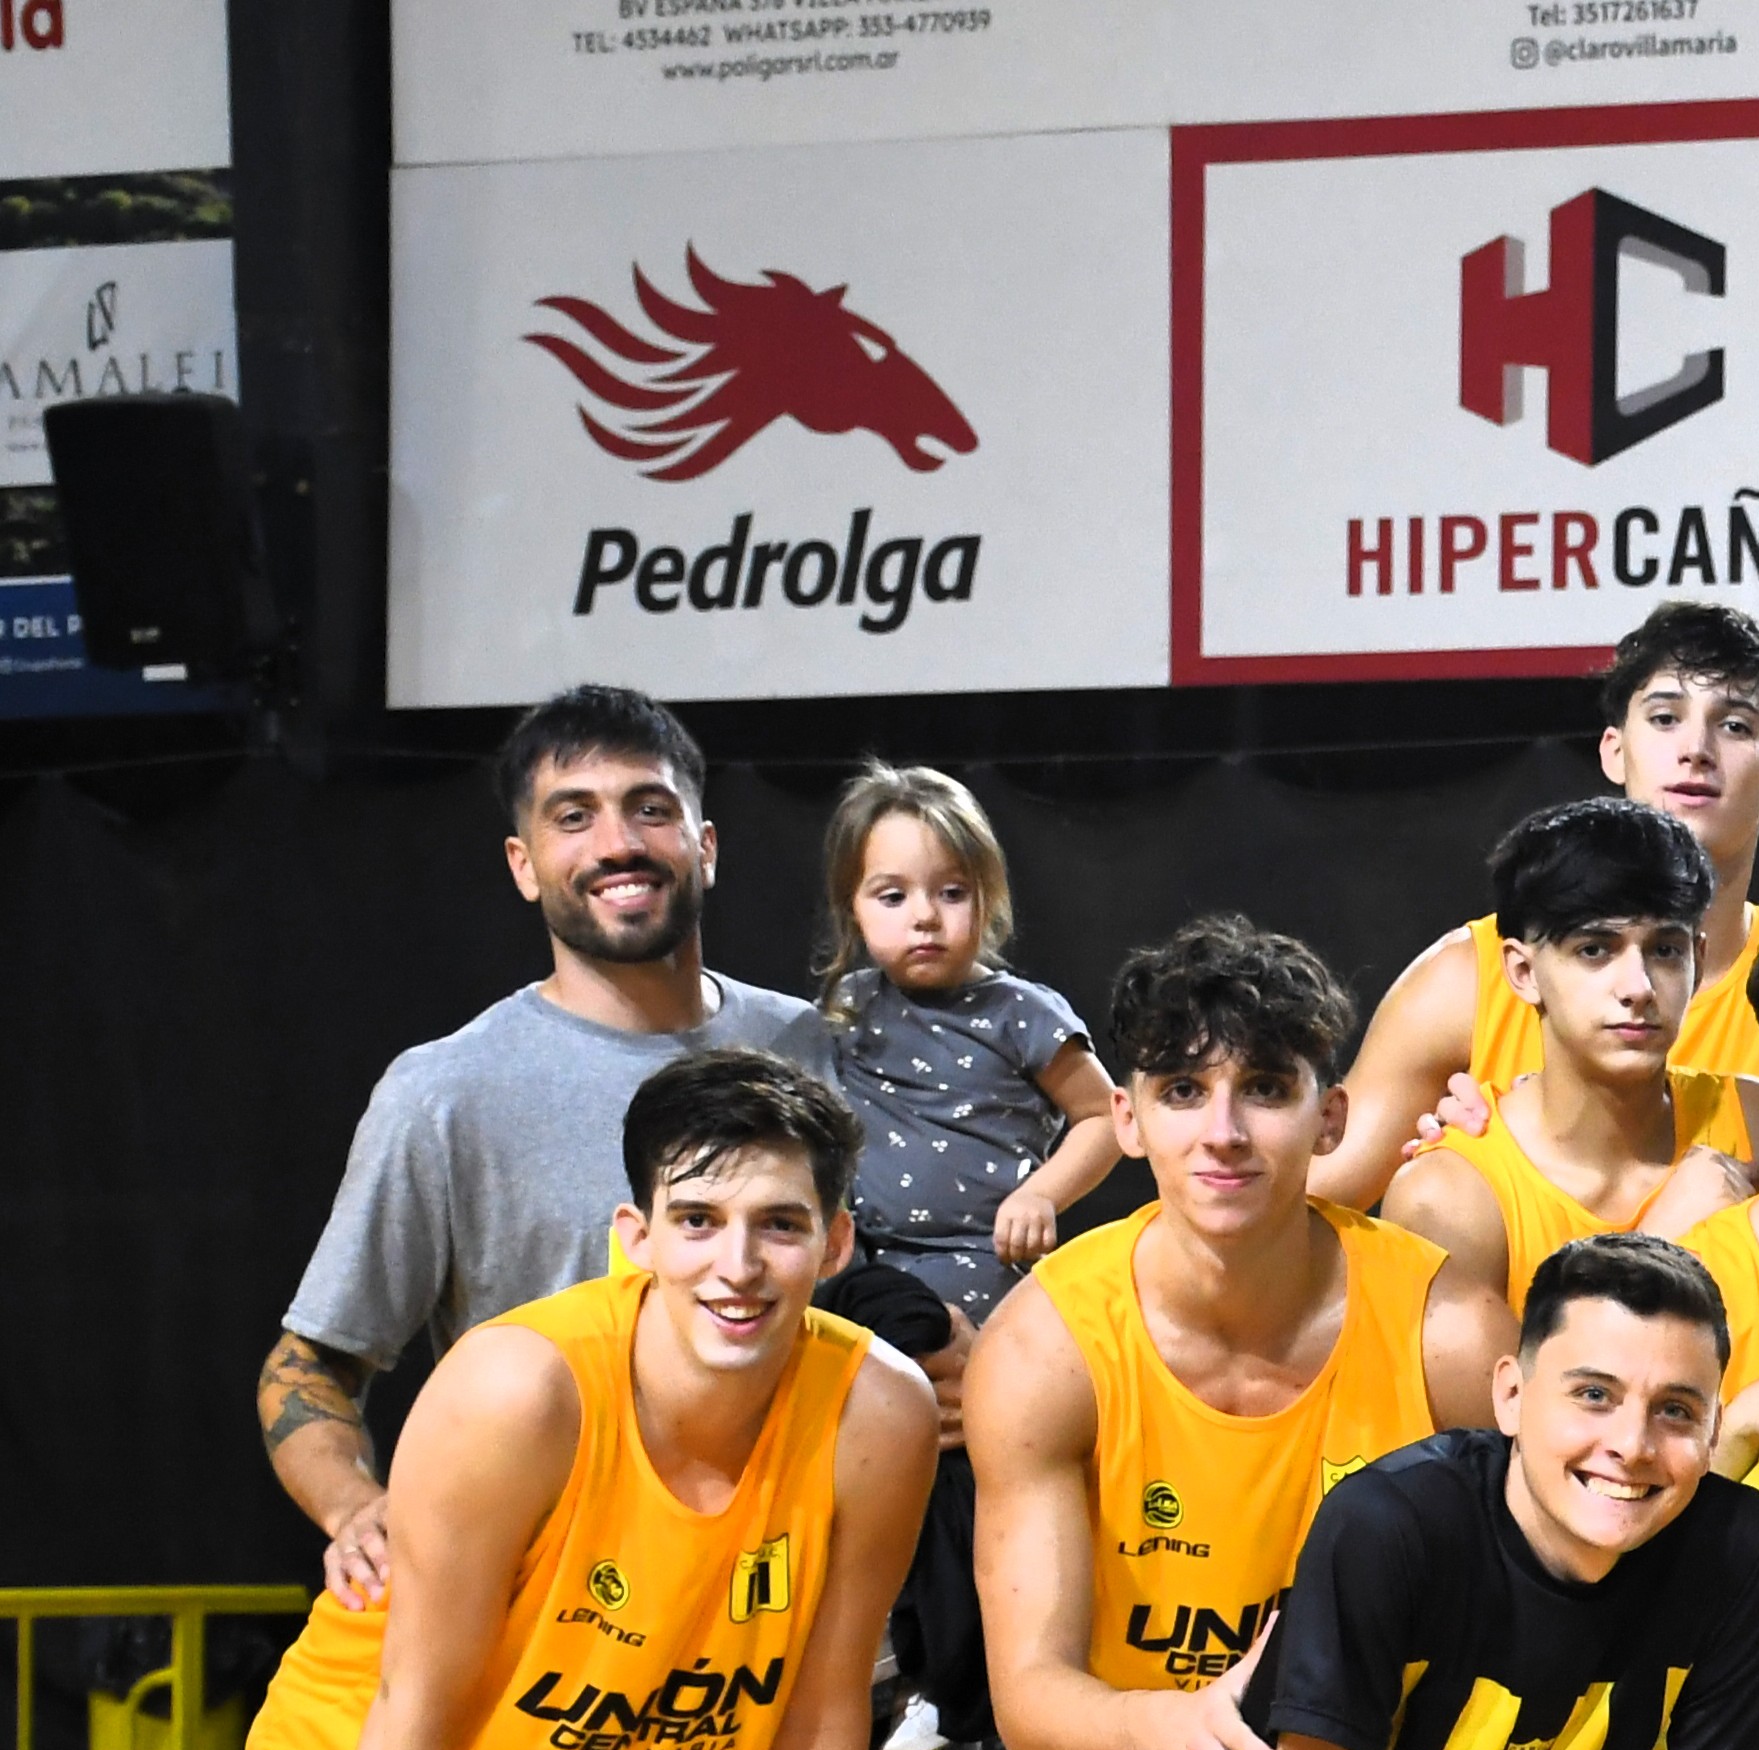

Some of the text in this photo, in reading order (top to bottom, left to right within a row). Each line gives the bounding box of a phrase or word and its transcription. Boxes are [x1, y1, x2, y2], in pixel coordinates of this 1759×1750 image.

[573, 9, 992, 54] TEL: 4534462 WHATSAPP: 353-4770939
[1527, 0, 1699, 27] Tel: 3517261637
[1544, 30, 1738, 67] @clarovillamaria
[572, 508, 982, 635] Pedrolga
[13, 615, 61, 639] DEL
